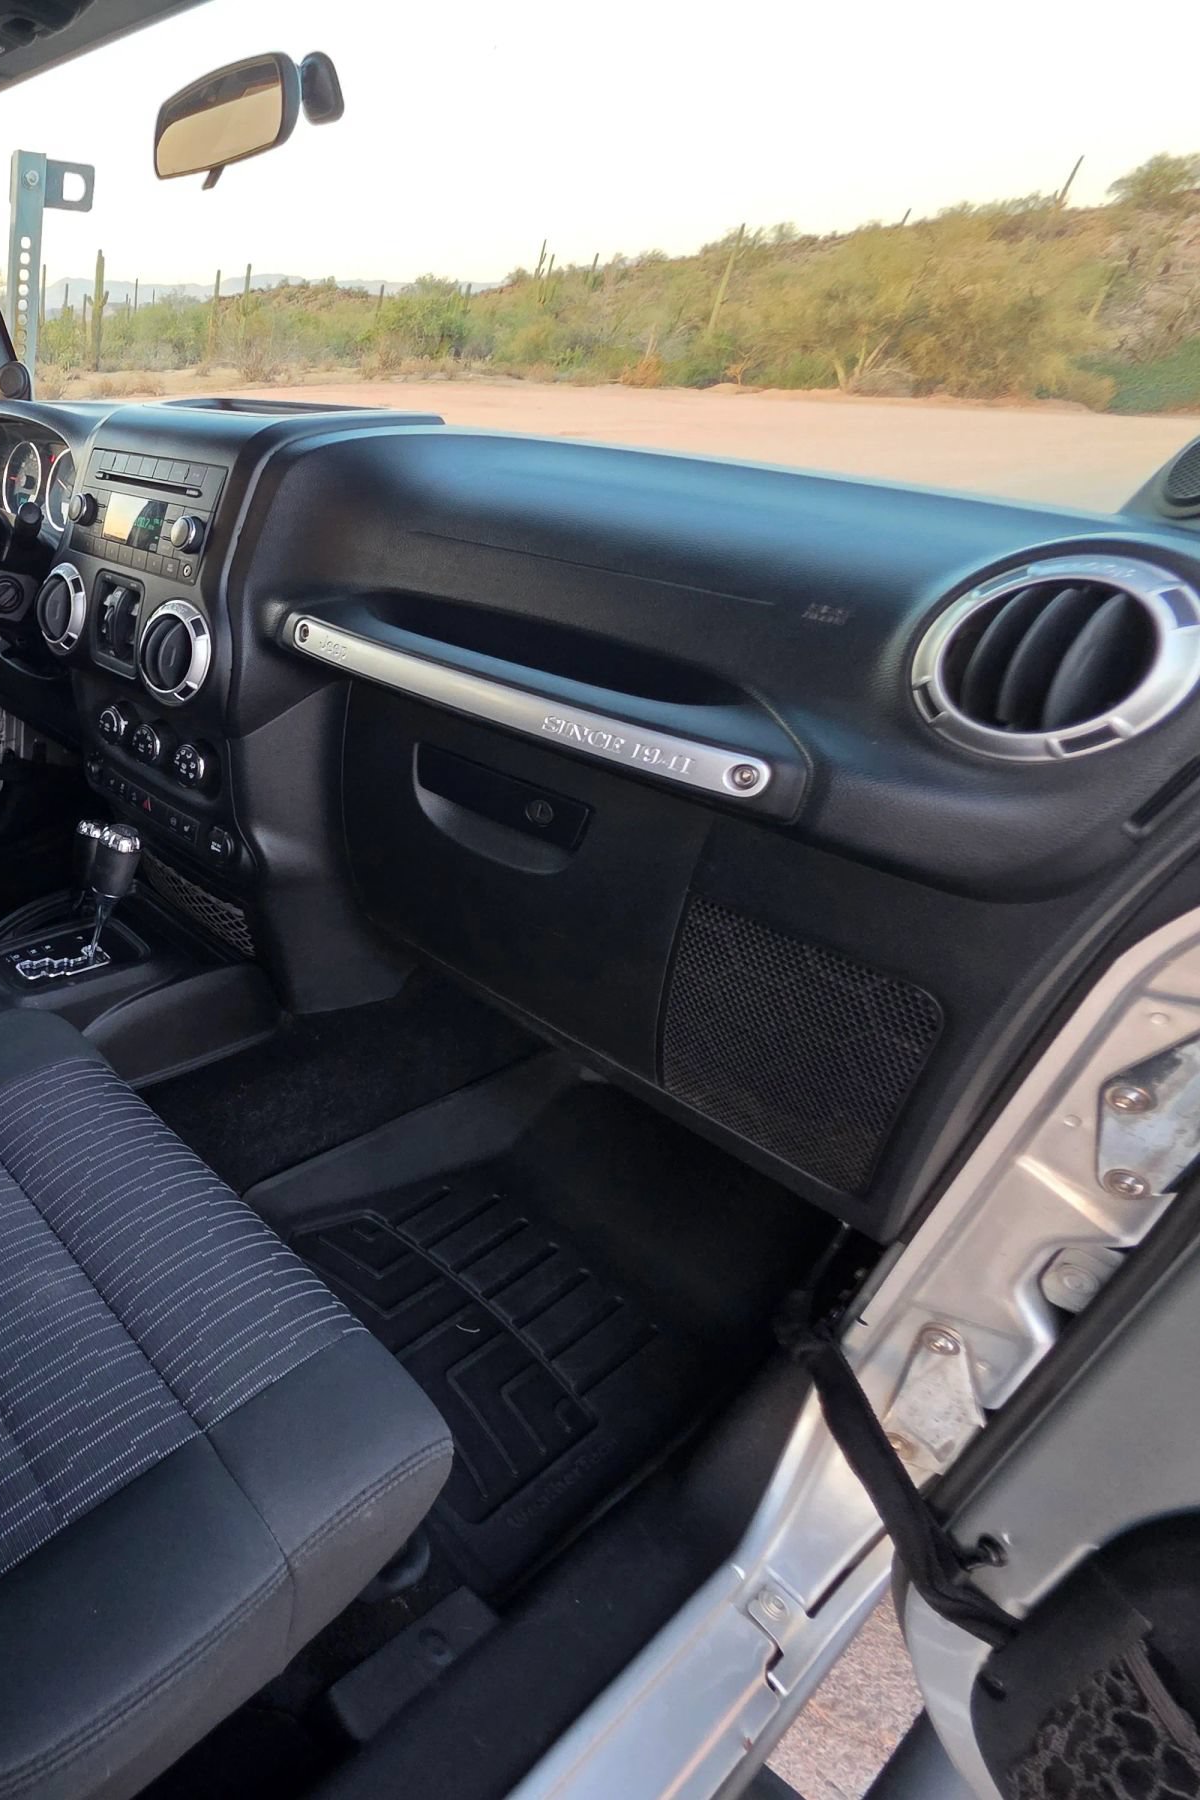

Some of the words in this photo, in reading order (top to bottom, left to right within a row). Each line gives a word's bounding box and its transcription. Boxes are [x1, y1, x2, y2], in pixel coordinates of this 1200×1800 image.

[319, 635, 349, 662] Jeep
[541, 715, 626, 754] SINCE
[630, 742, 697, 776] 1941
